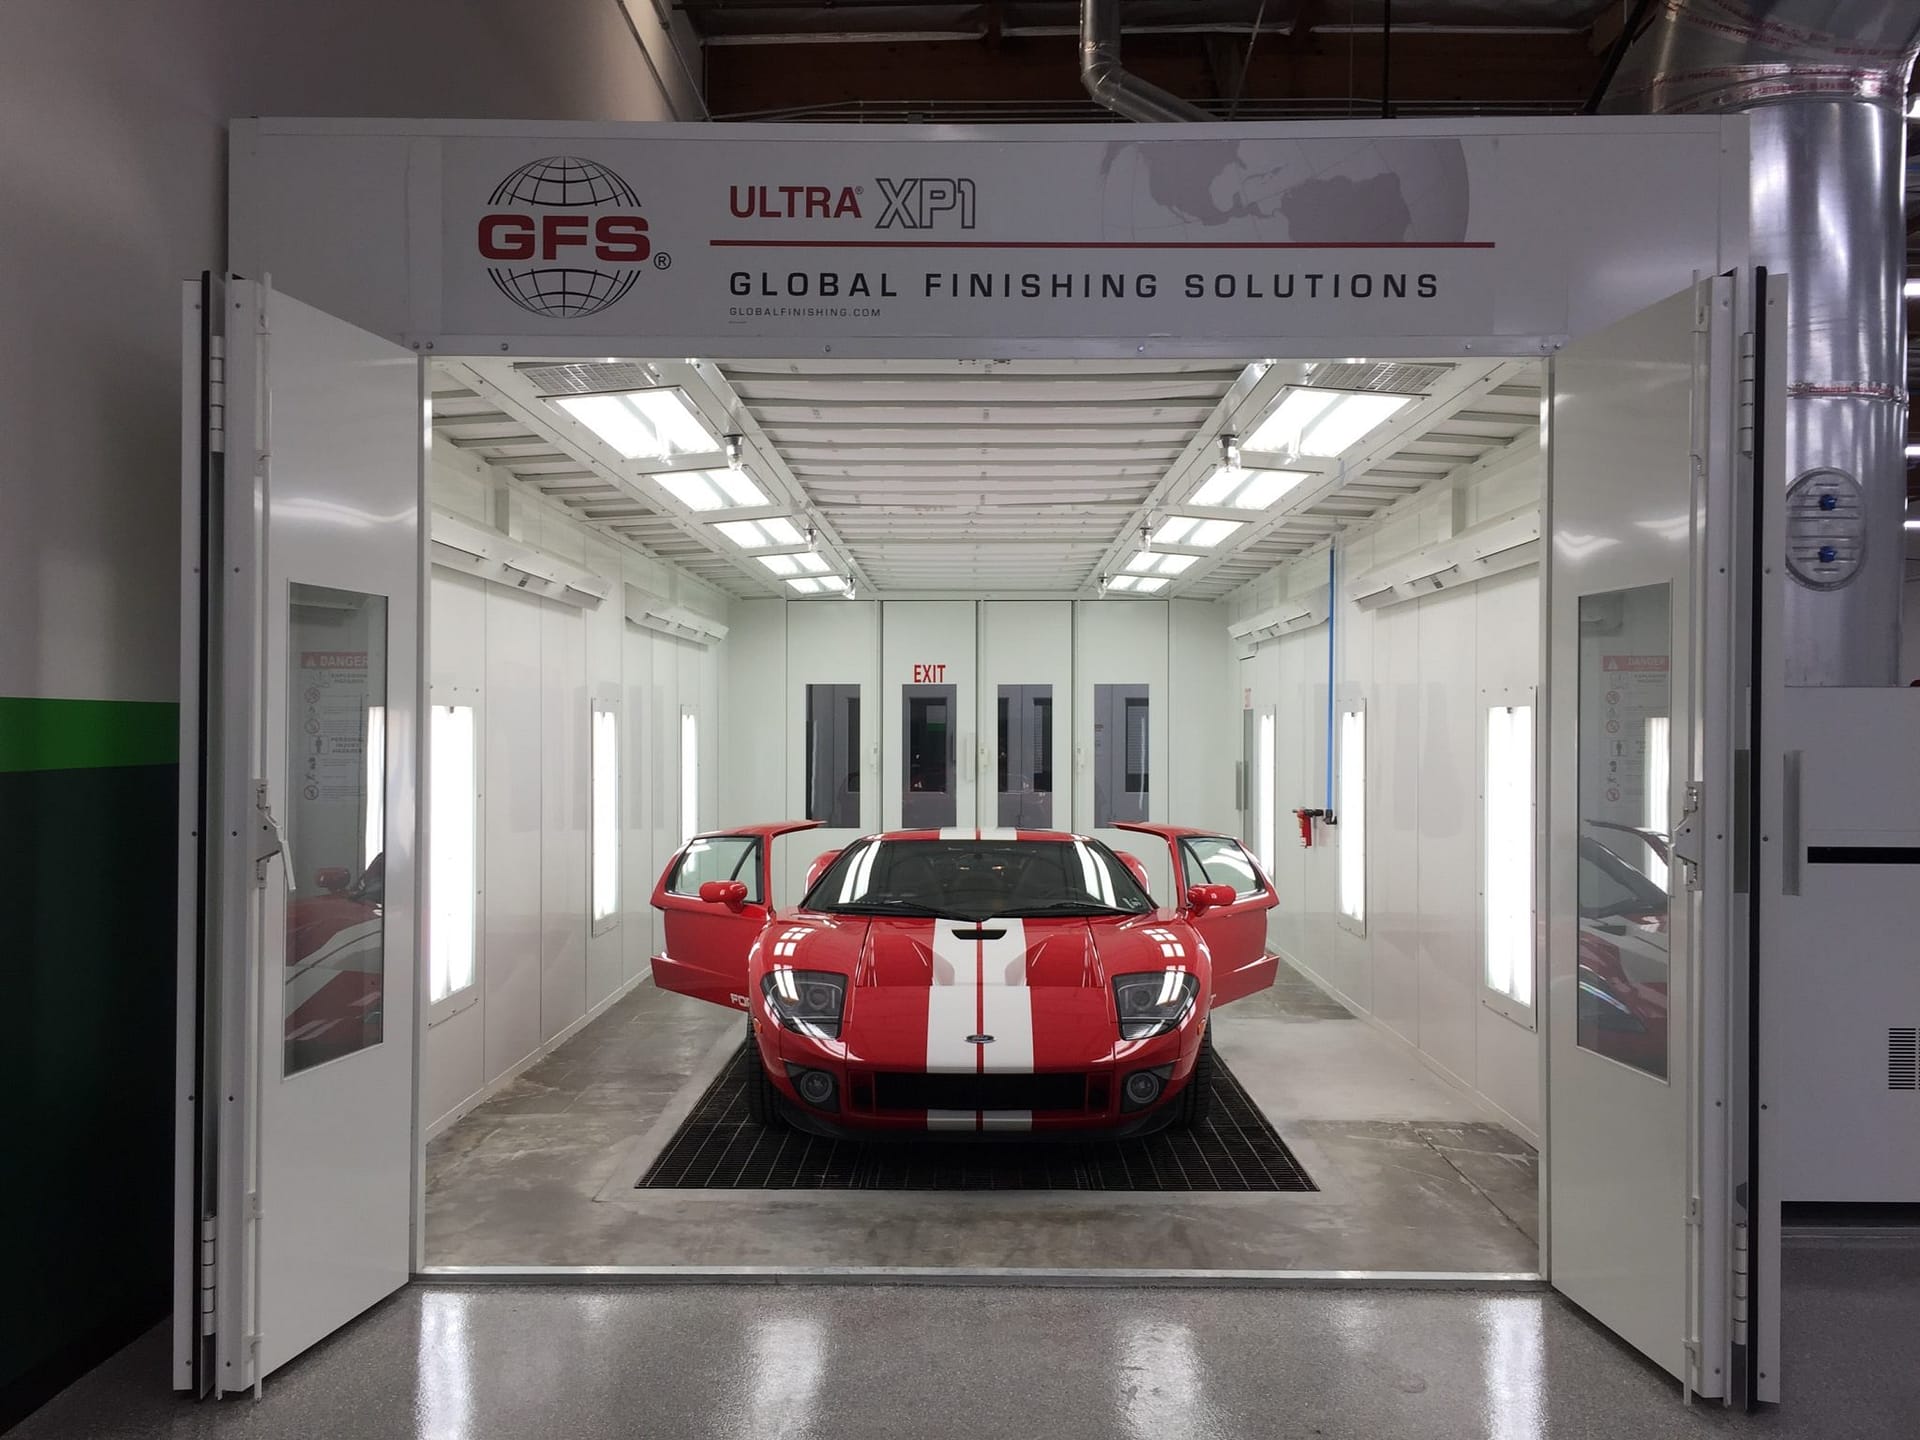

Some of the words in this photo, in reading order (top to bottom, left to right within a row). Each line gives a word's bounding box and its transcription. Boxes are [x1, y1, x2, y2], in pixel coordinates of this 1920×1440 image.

[874, 178, 976, 230] XP1
[729, 271, 898, 297] GLOBAL
[925, 272, 1157, 299] FINISHING
[1184, 272, 1439, 299] SOLUTIONS
[729, 307, 881, 317] GLOBALFINISHING.COM
[913, 664, 946, 683] EXIT
